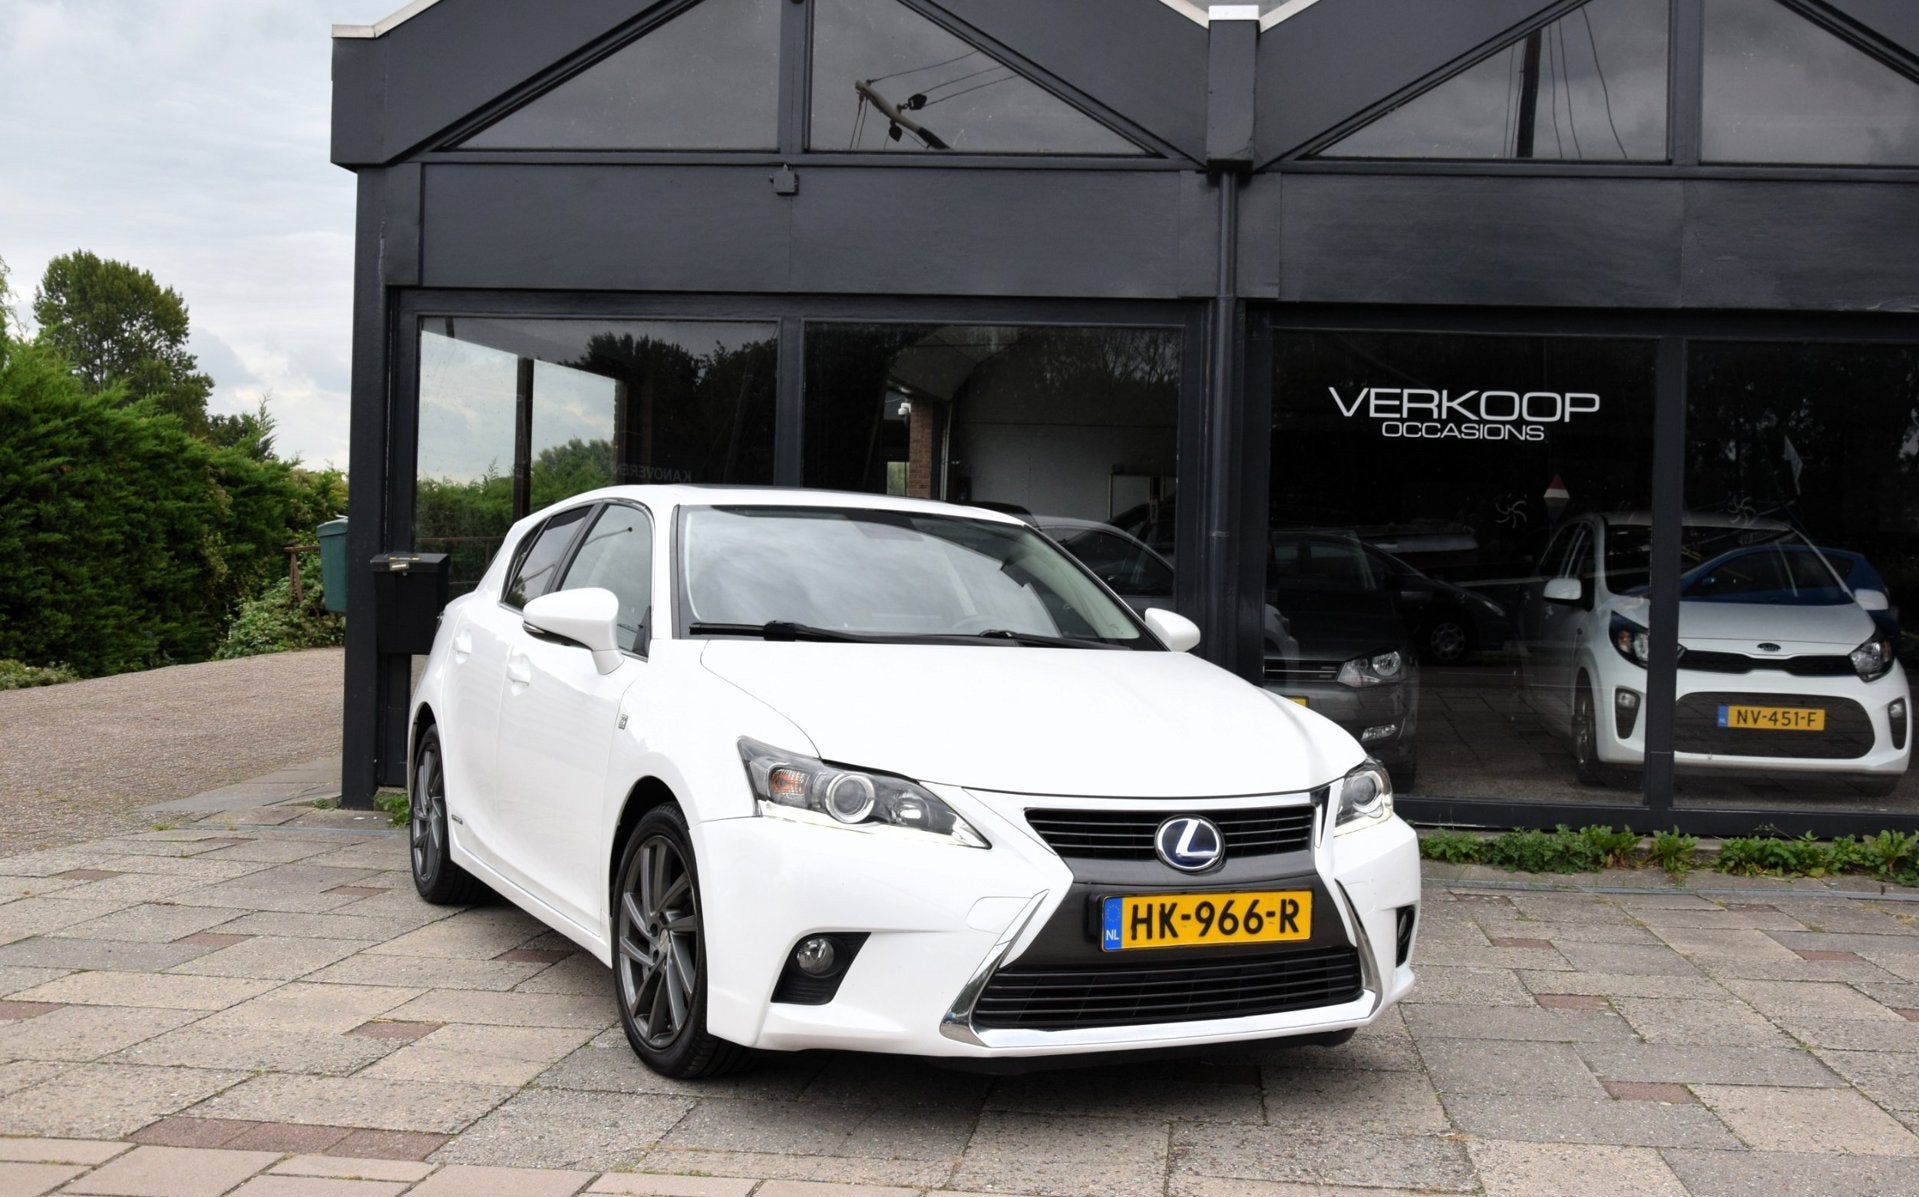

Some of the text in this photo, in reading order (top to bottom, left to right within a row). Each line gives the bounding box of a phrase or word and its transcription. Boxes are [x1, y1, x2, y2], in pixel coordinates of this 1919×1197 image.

[1328, 386, 1600, 423] VERKOOP
[1381, 421, 1545, 441] OCCASIONS
[1736, 709, 1817, 728] NV-451-F
[1105, 898, 1300, 941] NL HK-966-R
